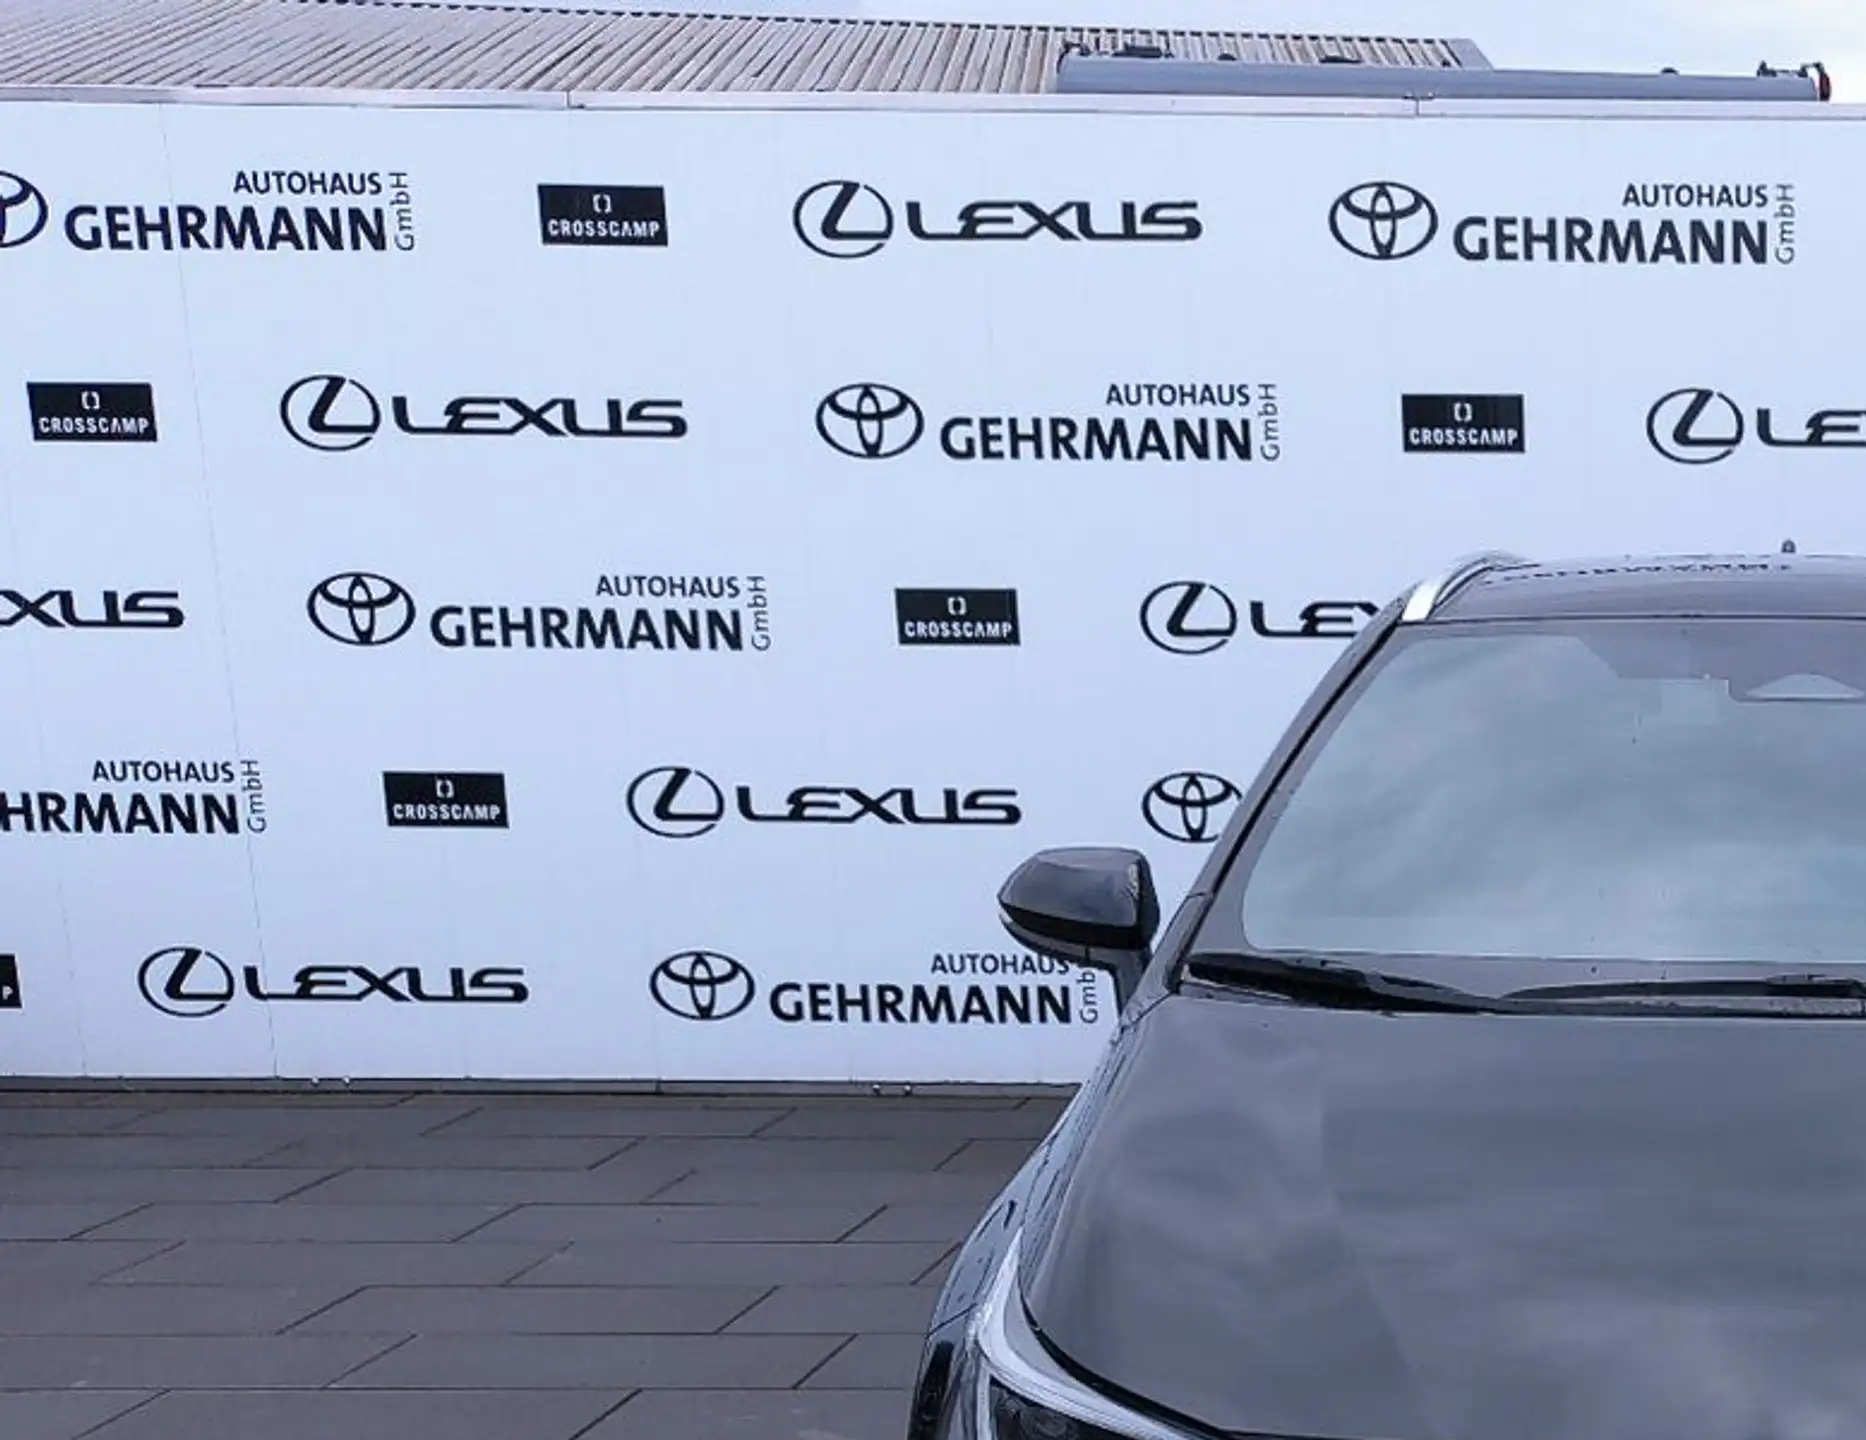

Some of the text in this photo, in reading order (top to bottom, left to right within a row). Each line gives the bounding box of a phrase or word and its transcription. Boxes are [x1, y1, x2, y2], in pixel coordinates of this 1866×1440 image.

[234, 171, 382, 195] AUTOHAUS
[1623, 184, 1768, 208] AUTOHAUS
[65, 205, 386, 250] GEHRMANN
[388, 172, 414, 251] GmbH
[548, 219, 659, 237] CROSSCAMP
[906, 201, 1202, 241] LEXUS
[1774, 184, 1795, 264] GmbH
[1454, 217, 1767, 264] GEHRMANN
[1106, 384, 1250, 406] AUTOHAUS
[39, 417, 149, 433] CROSSCAMP
[392, 396, 687, 437] LEXUS
[1258, 384, 1280, 461] GmbH
[941, 418, 1251, 460] GEHRMANN
[1410, 428, 1517, 445] CROSSCAMP
[596, 575, 740, 598] AUTOHAUS
[430, 606, 742, 651] GEHRMANN
[747, 576, 771, 651] GmbH
[905, 621, 1011, 637] CROSSCAMP
[1250, 600, 1378, 637] LE
[93, 760, 234, 783] AUTOHAUS
[0, 792, 239, 834] HRMANN
[243, 758, 267, 834] GmbH
[393, 804, 500, 820] CROSSCAMP
[737, 786, 1021, 825] LEXUS
[244, 966, 528, 1003] LEXUS
[930, 954, 1069, 976] AUTOHAUS
[770, 983, 1071, 1024] GEHRMANN
[1077, 970, 1099, 1024] Gmb
